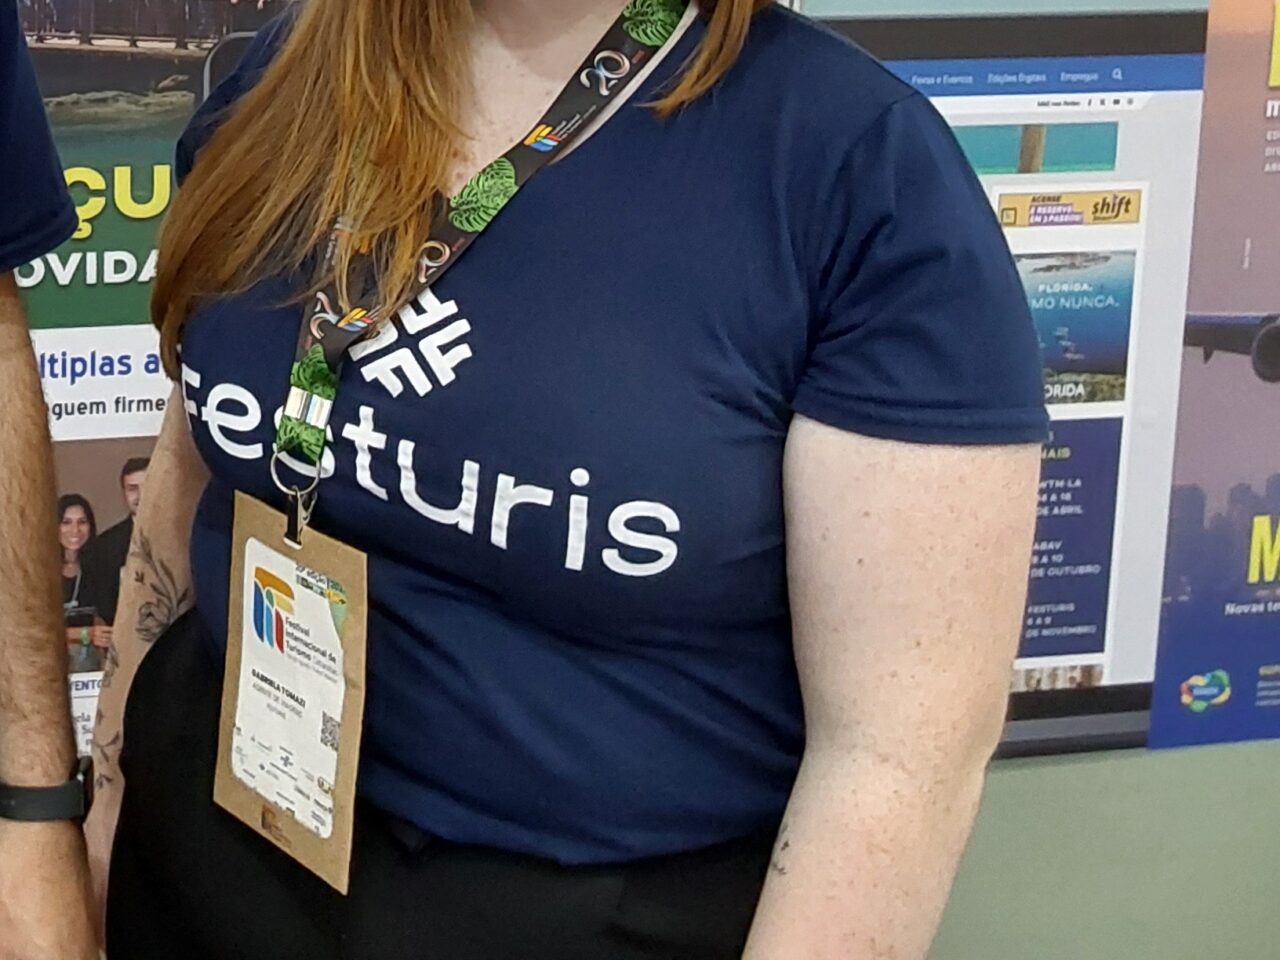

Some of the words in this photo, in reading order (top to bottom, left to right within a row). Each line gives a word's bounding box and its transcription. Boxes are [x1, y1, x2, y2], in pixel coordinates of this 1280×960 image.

[63, 164, 171, 240] ÇU
[1092, 193, 1132, 218] shift
[1059, 295, 1120, 310] NUNCA.
[52, 400, 107, 421] guem
[115, 396, 166, 414] firme
